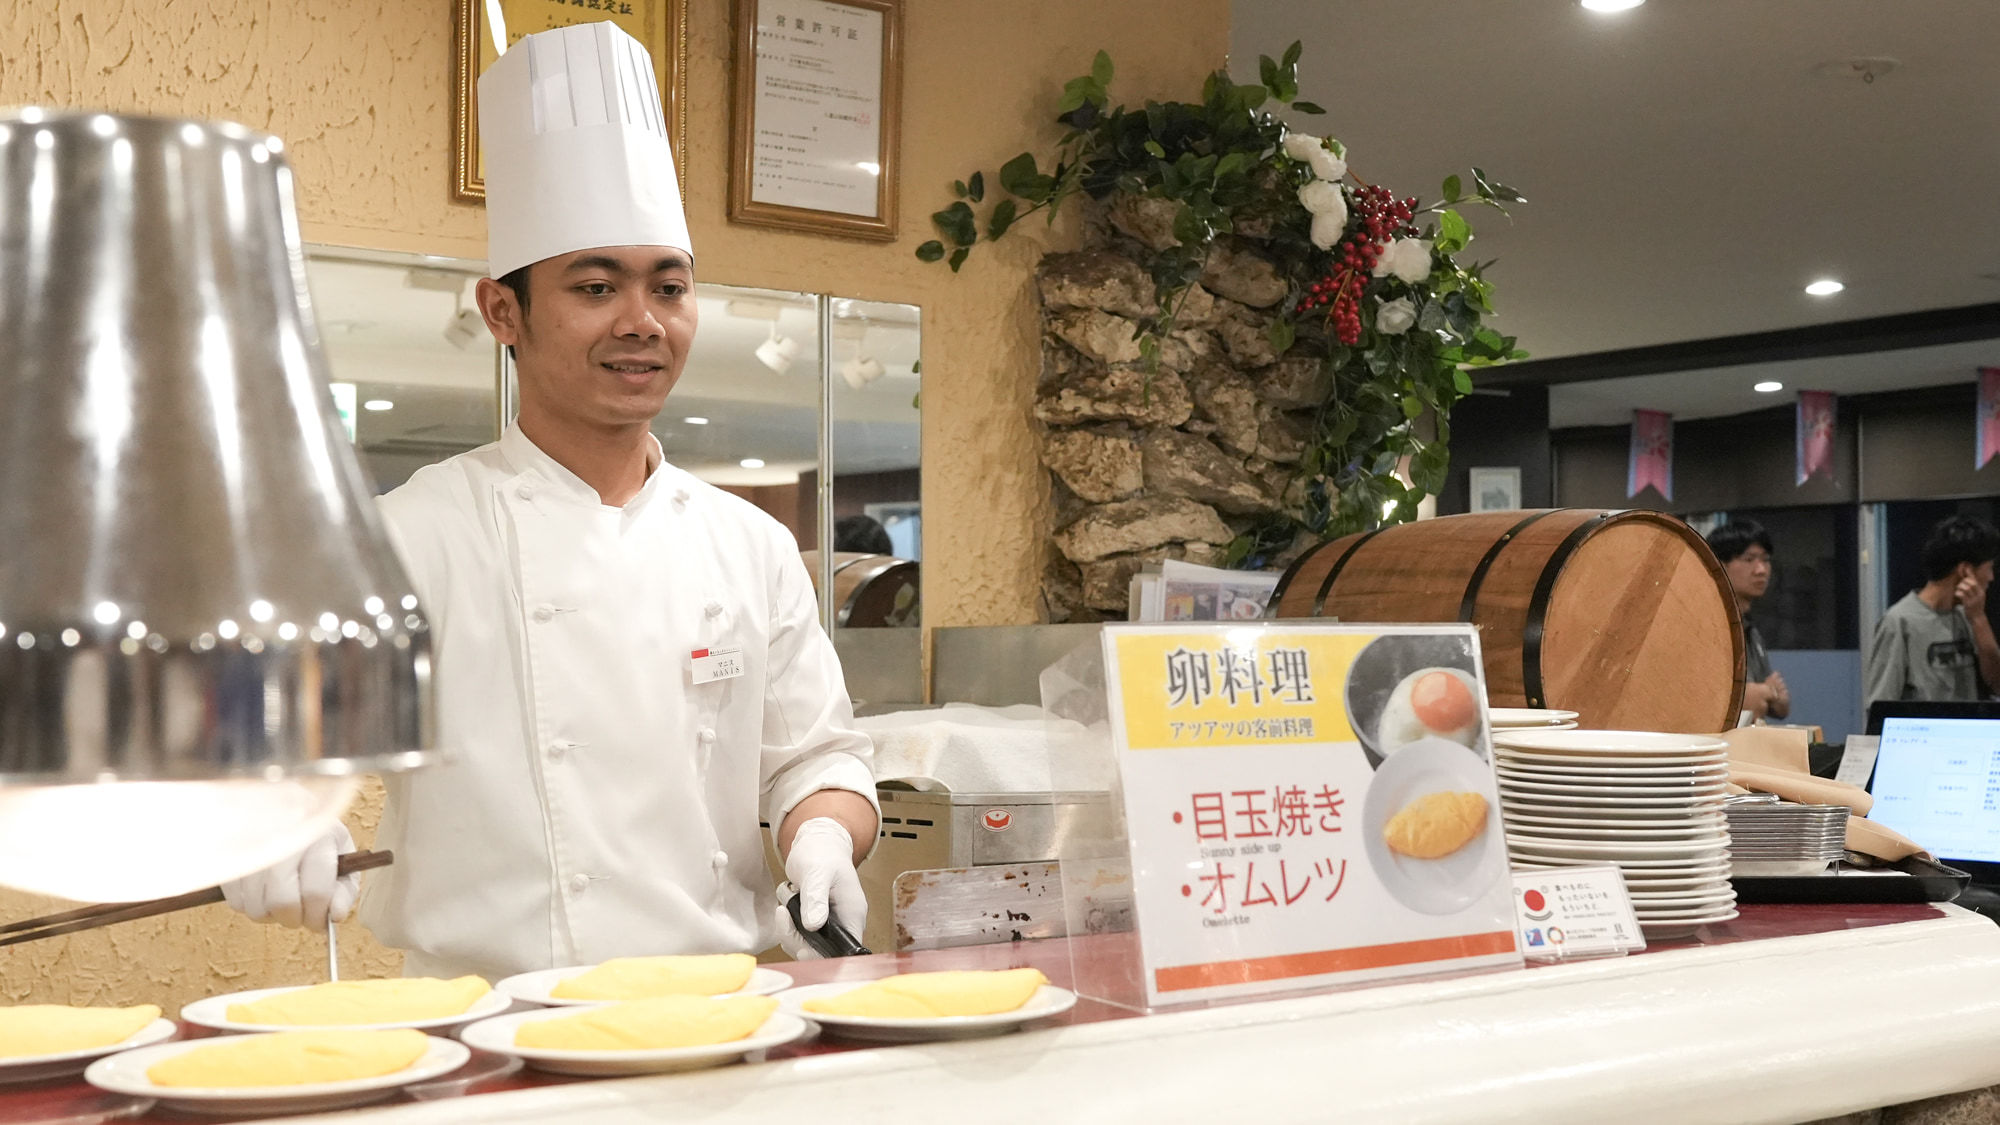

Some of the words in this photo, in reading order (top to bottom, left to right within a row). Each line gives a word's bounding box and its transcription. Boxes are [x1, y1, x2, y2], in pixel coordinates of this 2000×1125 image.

[776, 15, 858, 40] 営業許可証
[1167, 648, 1314, 706] 卵料理
[1170, 718, 1315, 740] アツアツの客前料理
[1200, 846, 1236, 859] Sunny
[1240, 843, 1264, 855] side
[1268, 842, 1282, 853] up
[1202, 915, 1251, 928] Omelette
